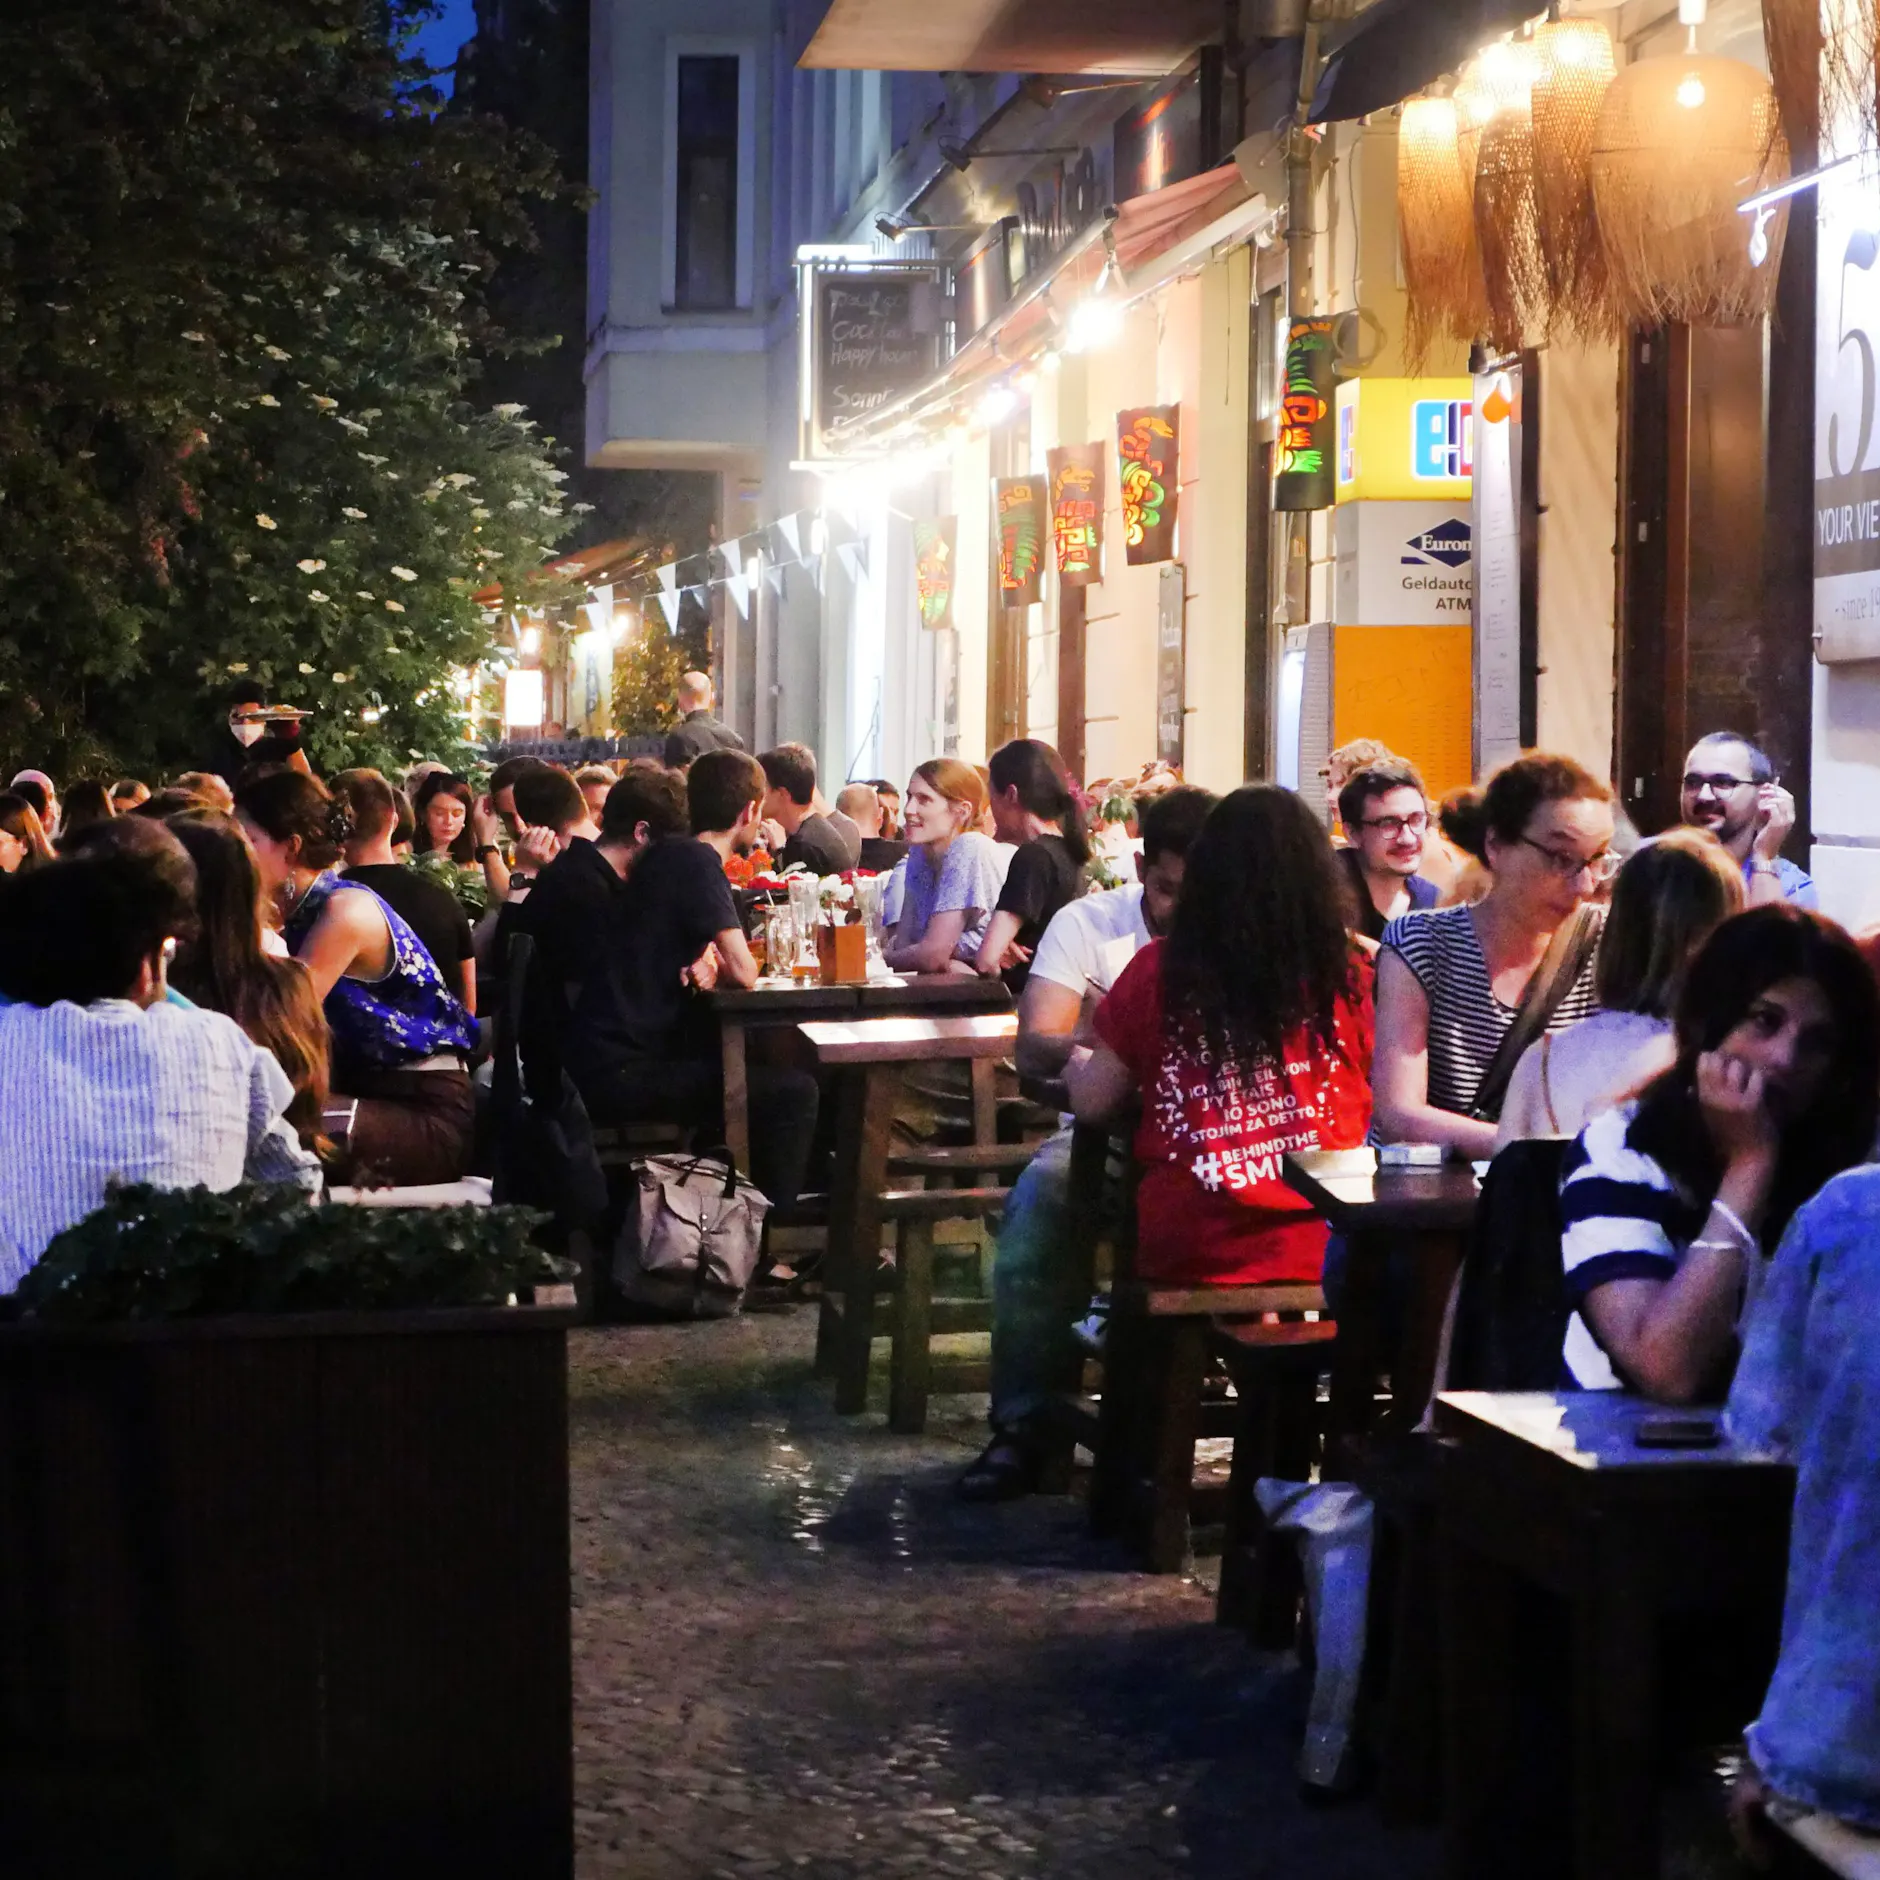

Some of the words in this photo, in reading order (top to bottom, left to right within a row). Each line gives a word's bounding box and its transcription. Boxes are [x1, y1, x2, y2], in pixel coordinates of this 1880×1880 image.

[831, 342, 878, 369] Happy
[1818, 504, 1853, 546] YOUR
[1856, 500, 1880, 540] VIE
[1421, 534, 1472, 551] Euron
[1435, 597, 1472, 611] ATM
[1246, 1094, 1297, 1117] SONO
[1246, 1116, 1266, 1132] ZA
